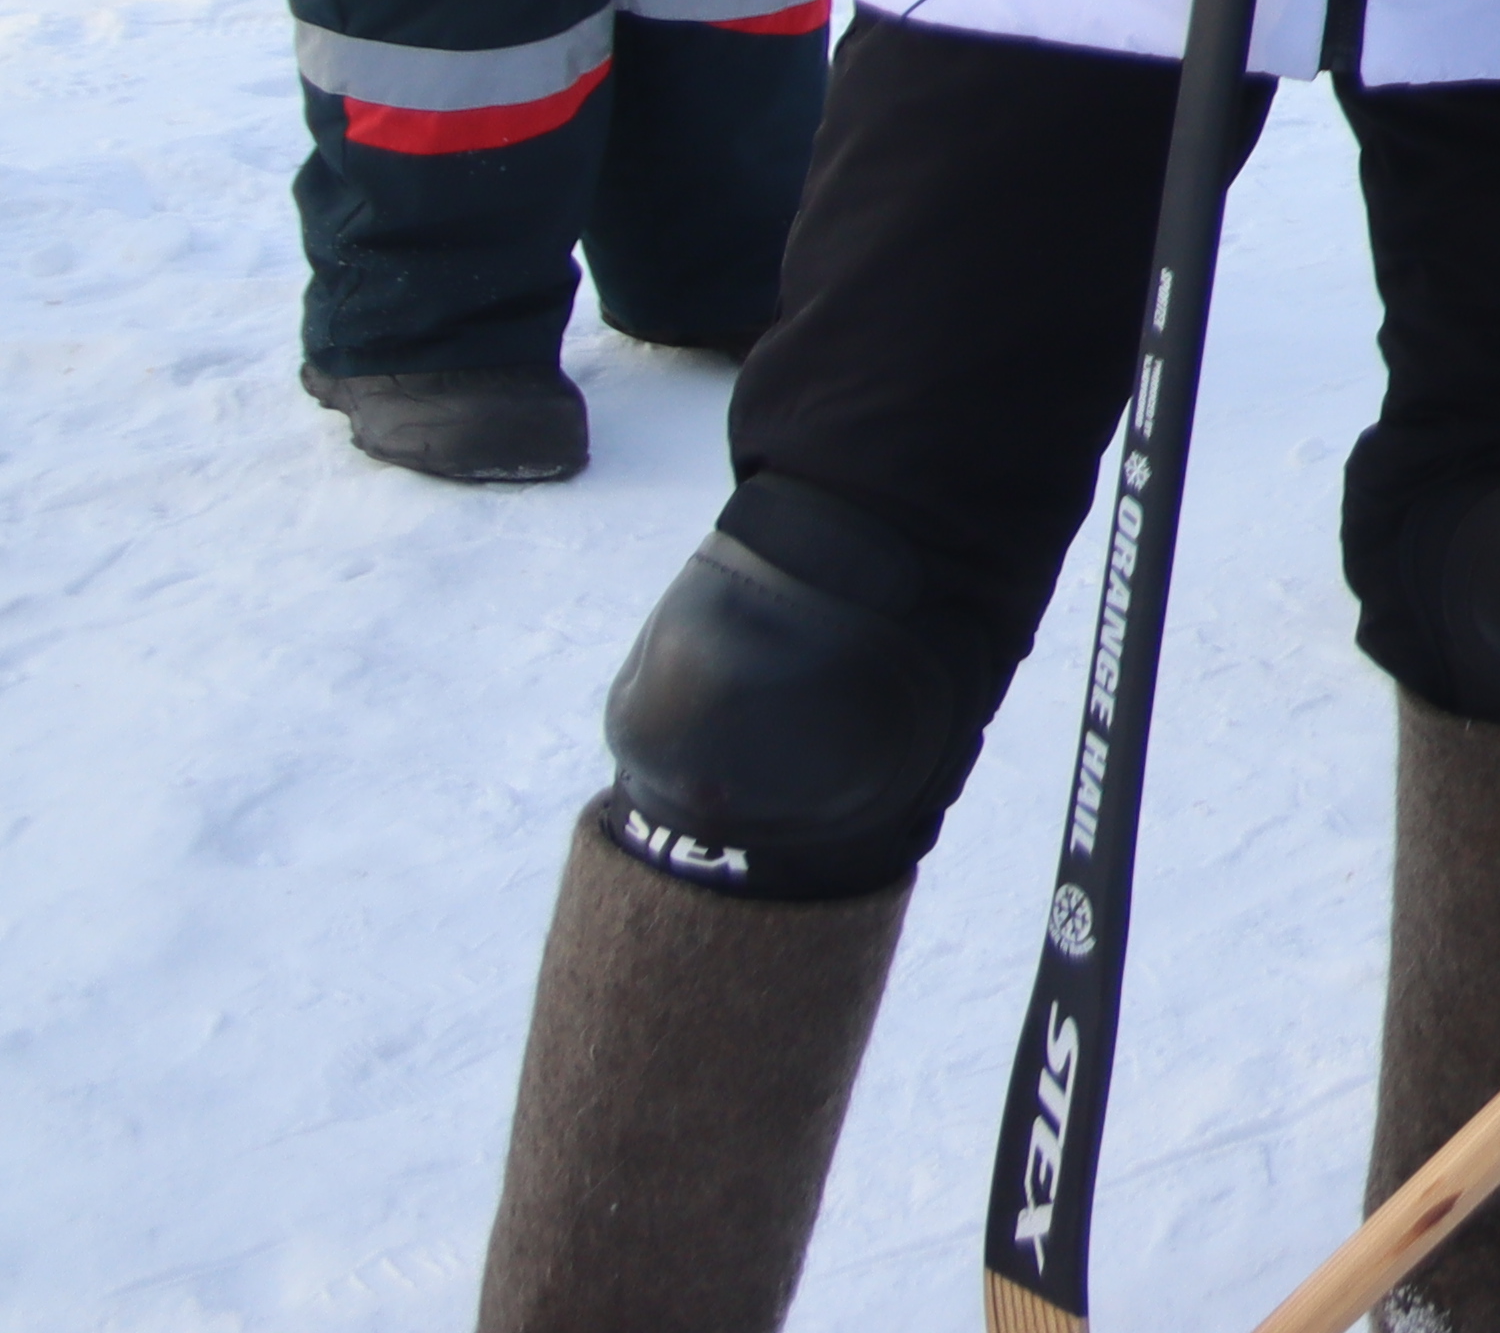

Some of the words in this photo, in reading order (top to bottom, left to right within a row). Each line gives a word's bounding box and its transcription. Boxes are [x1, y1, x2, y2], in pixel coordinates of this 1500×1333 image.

[1090, 493, 1144, 732] ORANGE
[1070, 730, 1110, 856] HAIL
[1014, 998, 1080, 1277] STEX
